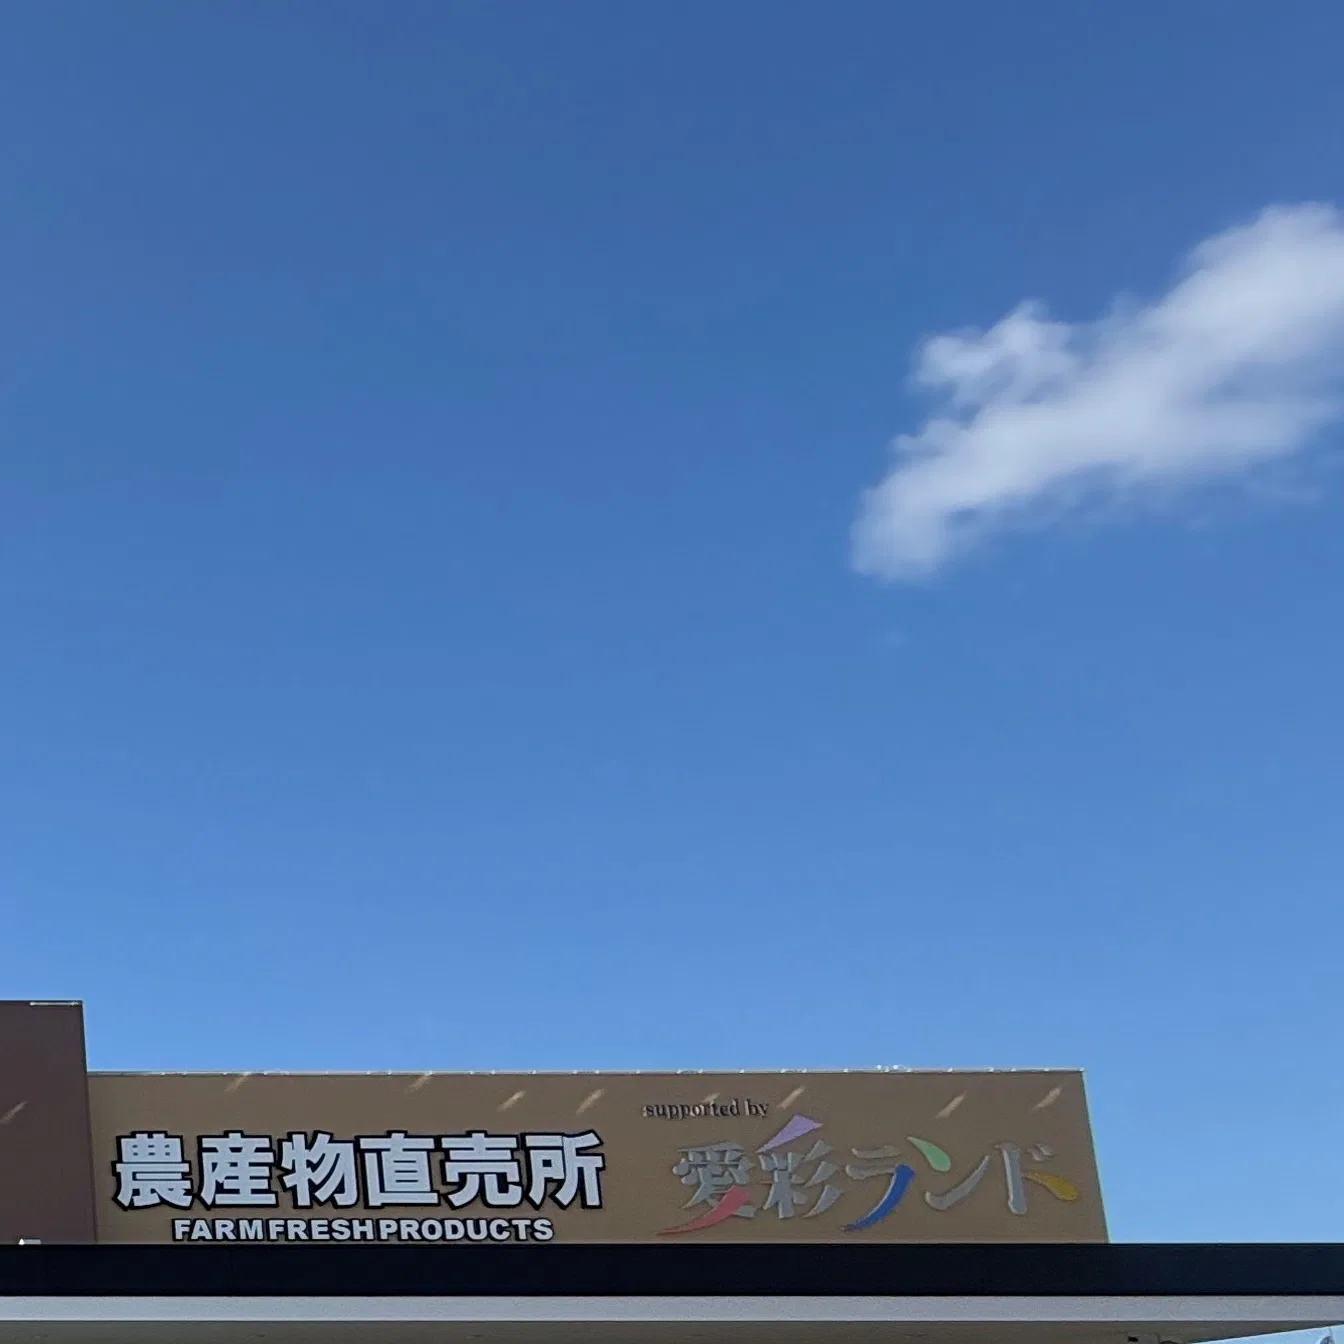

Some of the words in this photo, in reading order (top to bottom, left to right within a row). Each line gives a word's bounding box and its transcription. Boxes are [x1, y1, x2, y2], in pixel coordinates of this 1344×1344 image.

[642, 1099, 740, 1119] supported
[744, 1099, 769, 1117] by
[112, 1129, 604, 1211] 農産物直売所
[655, 1113, 1079, 1235] 愛彩ランド
